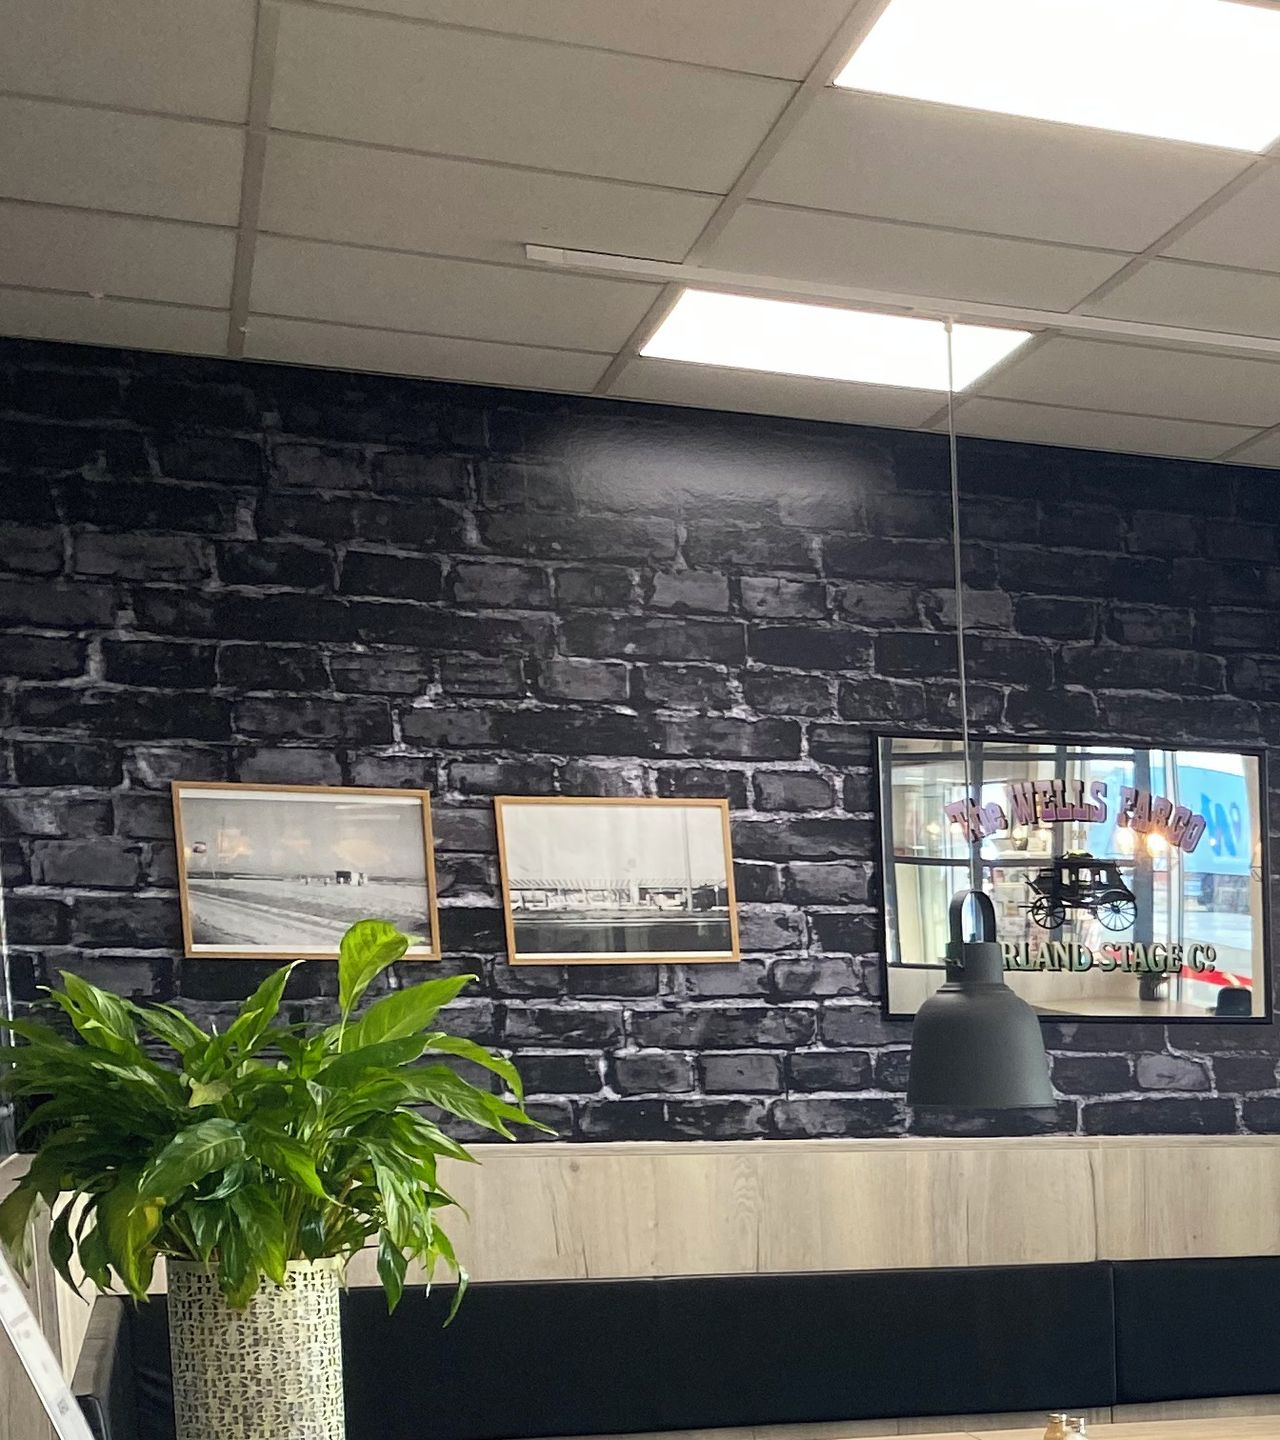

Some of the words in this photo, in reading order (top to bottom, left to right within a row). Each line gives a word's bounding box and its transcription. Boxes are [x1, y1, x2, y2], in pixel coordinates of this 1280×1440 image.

[1007, 779, 1108, 826] WELLS
[1117, 785, 1207, 854] FARGO
[1001, 941, 1094, 972] RLAND
[1100, 942, 1183, 973] STAGE
